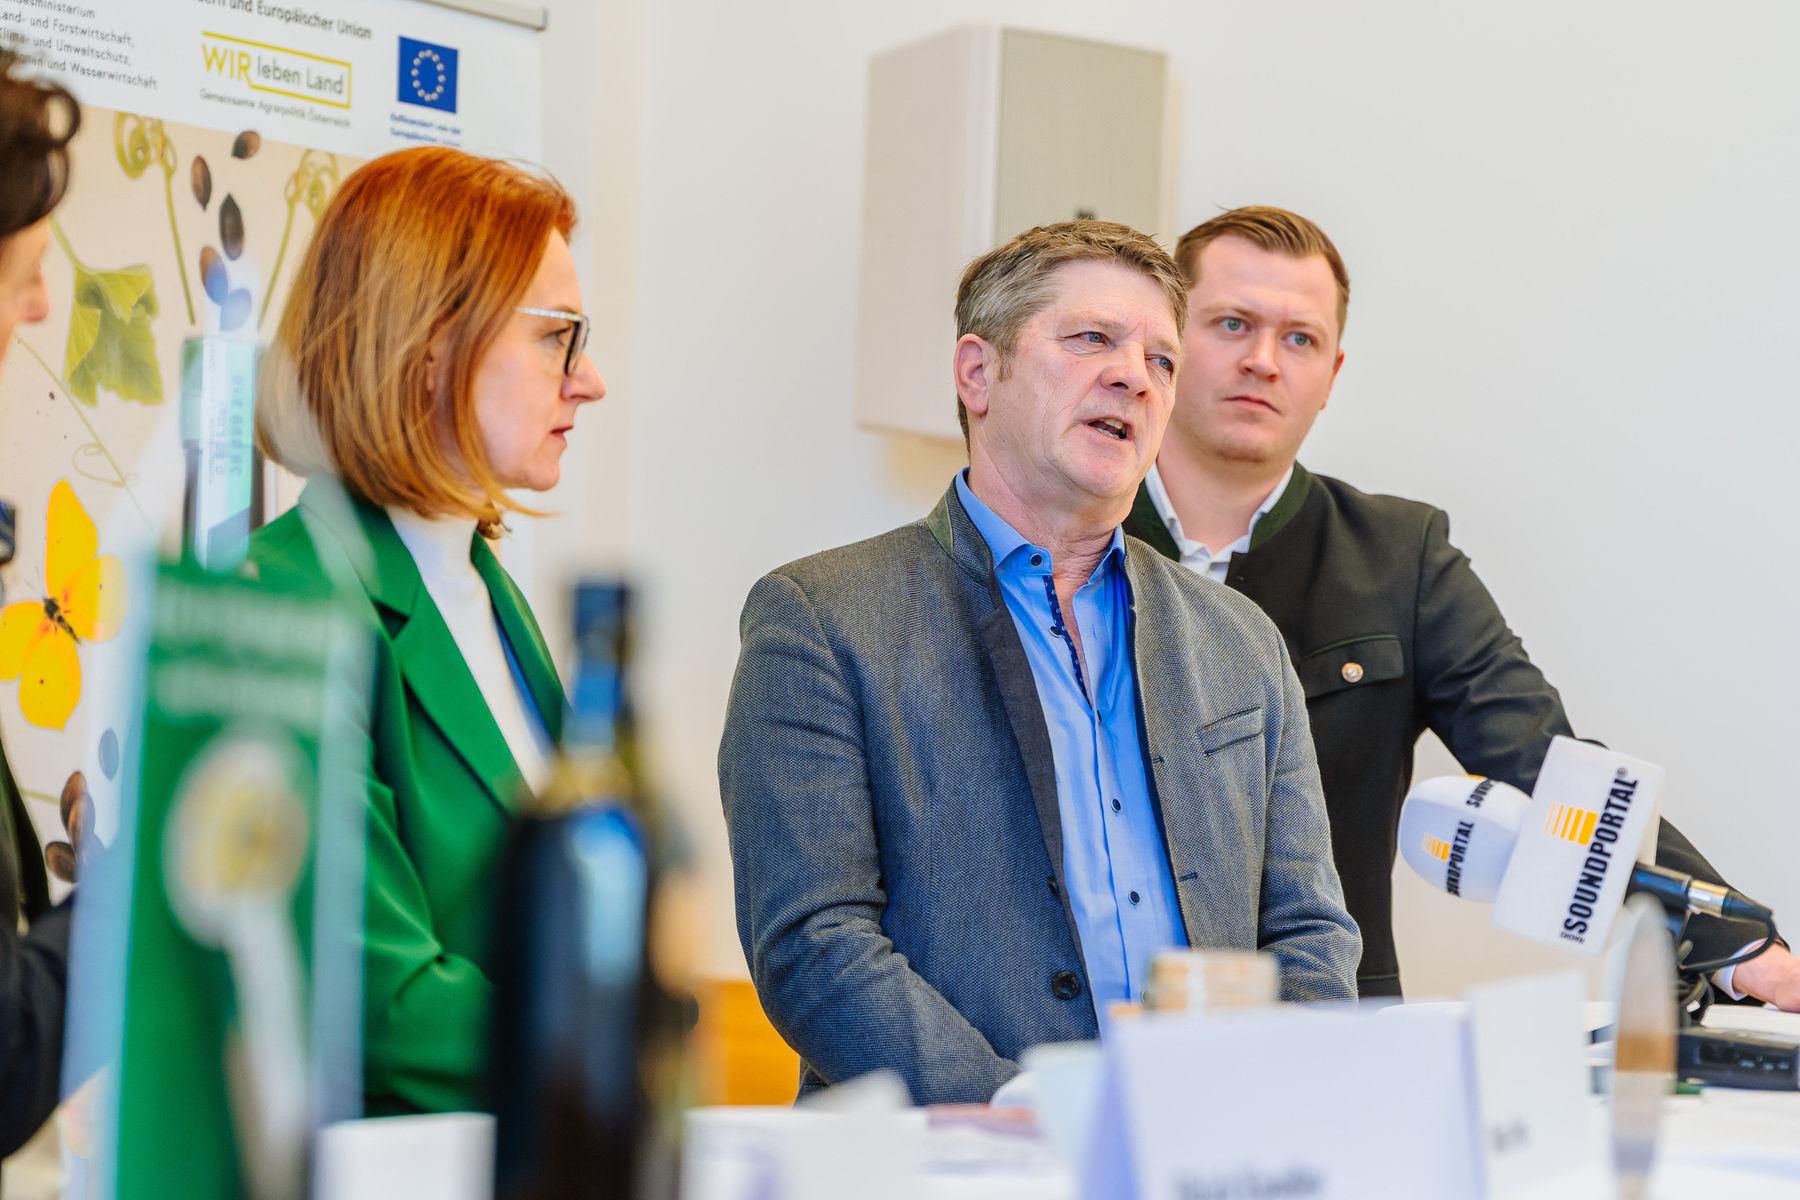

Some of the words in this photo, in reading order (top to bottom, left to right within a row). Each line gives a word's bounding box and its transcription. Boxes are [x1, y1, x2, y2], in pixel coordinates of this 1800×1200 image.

[0, 11, 26, 23] and-
[30, 17, 49, 29] und
[257, 1, 333, 31] Europäischer
[338, 19, 372, 40] Union
[34, 37, 52, 49] und
[47, 59, 66, 71] und
[70, 60, 157, 90] Wasserwirtschaft
[201, 43, 251, 83] WIR
[257, 56, 300, 85] leben
[306, 70, 343, 96] Land
